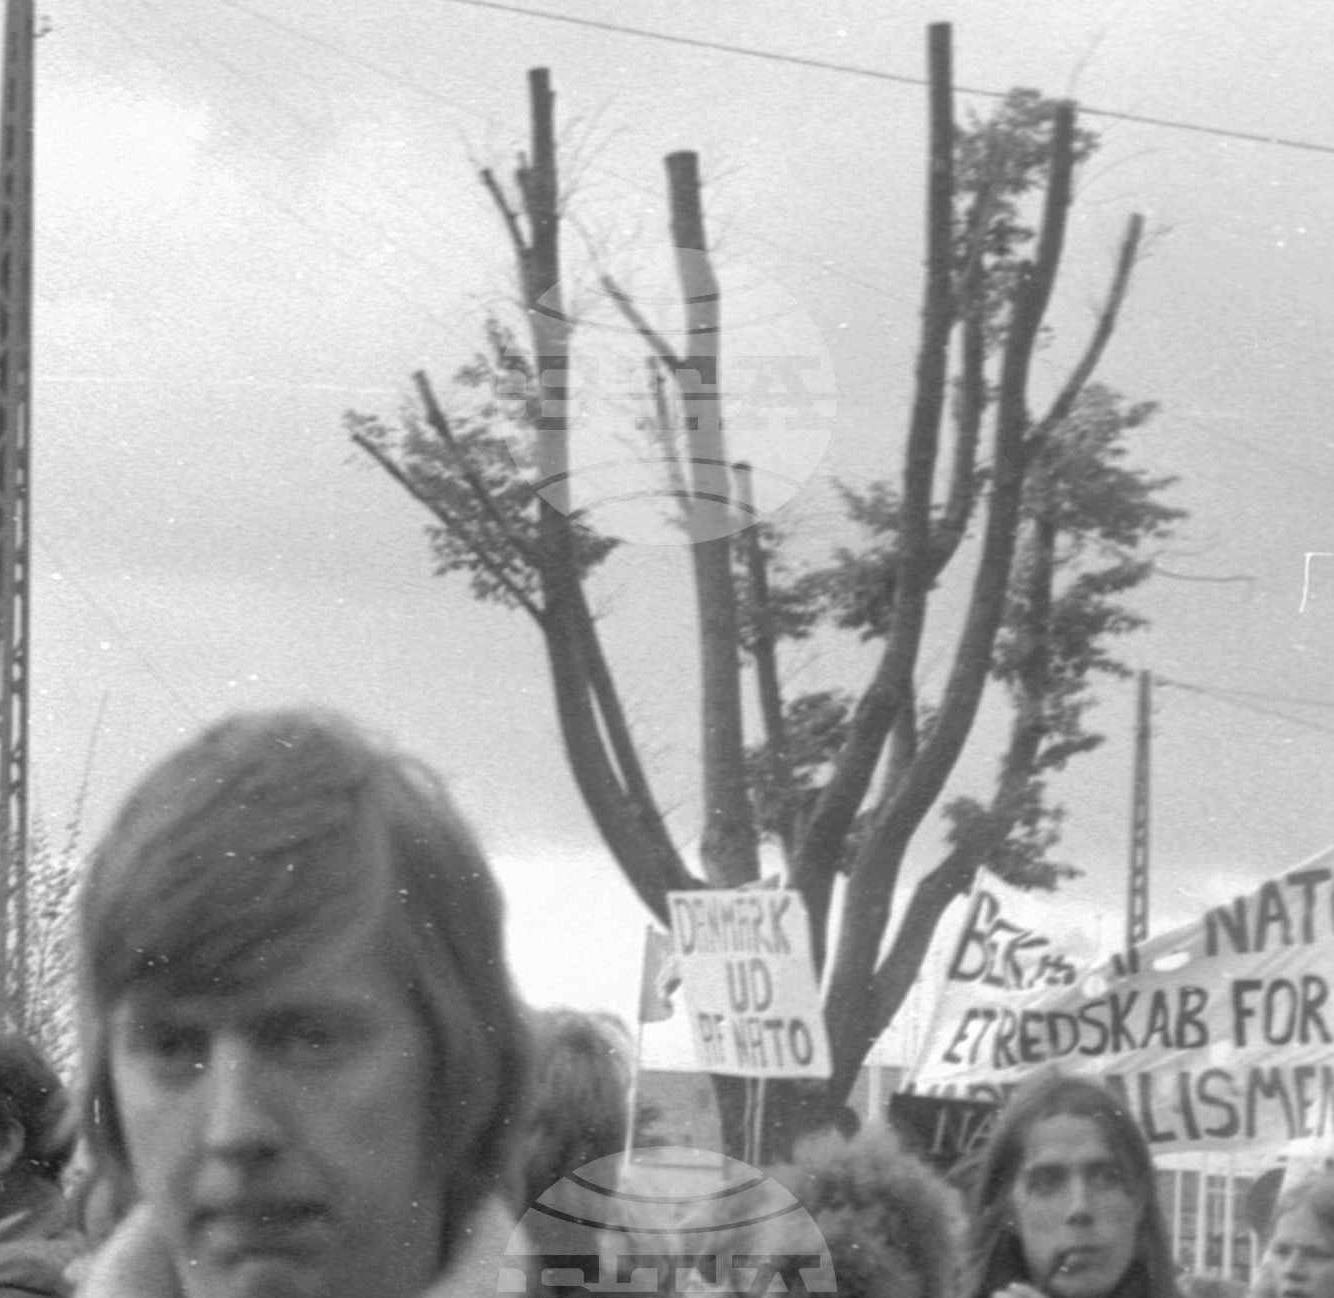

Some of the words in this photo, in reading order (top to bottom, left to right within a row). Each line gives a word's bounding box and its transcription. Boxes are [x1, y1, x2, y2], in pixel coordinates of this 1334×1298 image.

[726, 958, 772, 1013] UD
[1231, 974, 1333, 1048] FOR
[731, 1017, 813, 1068] NATO
